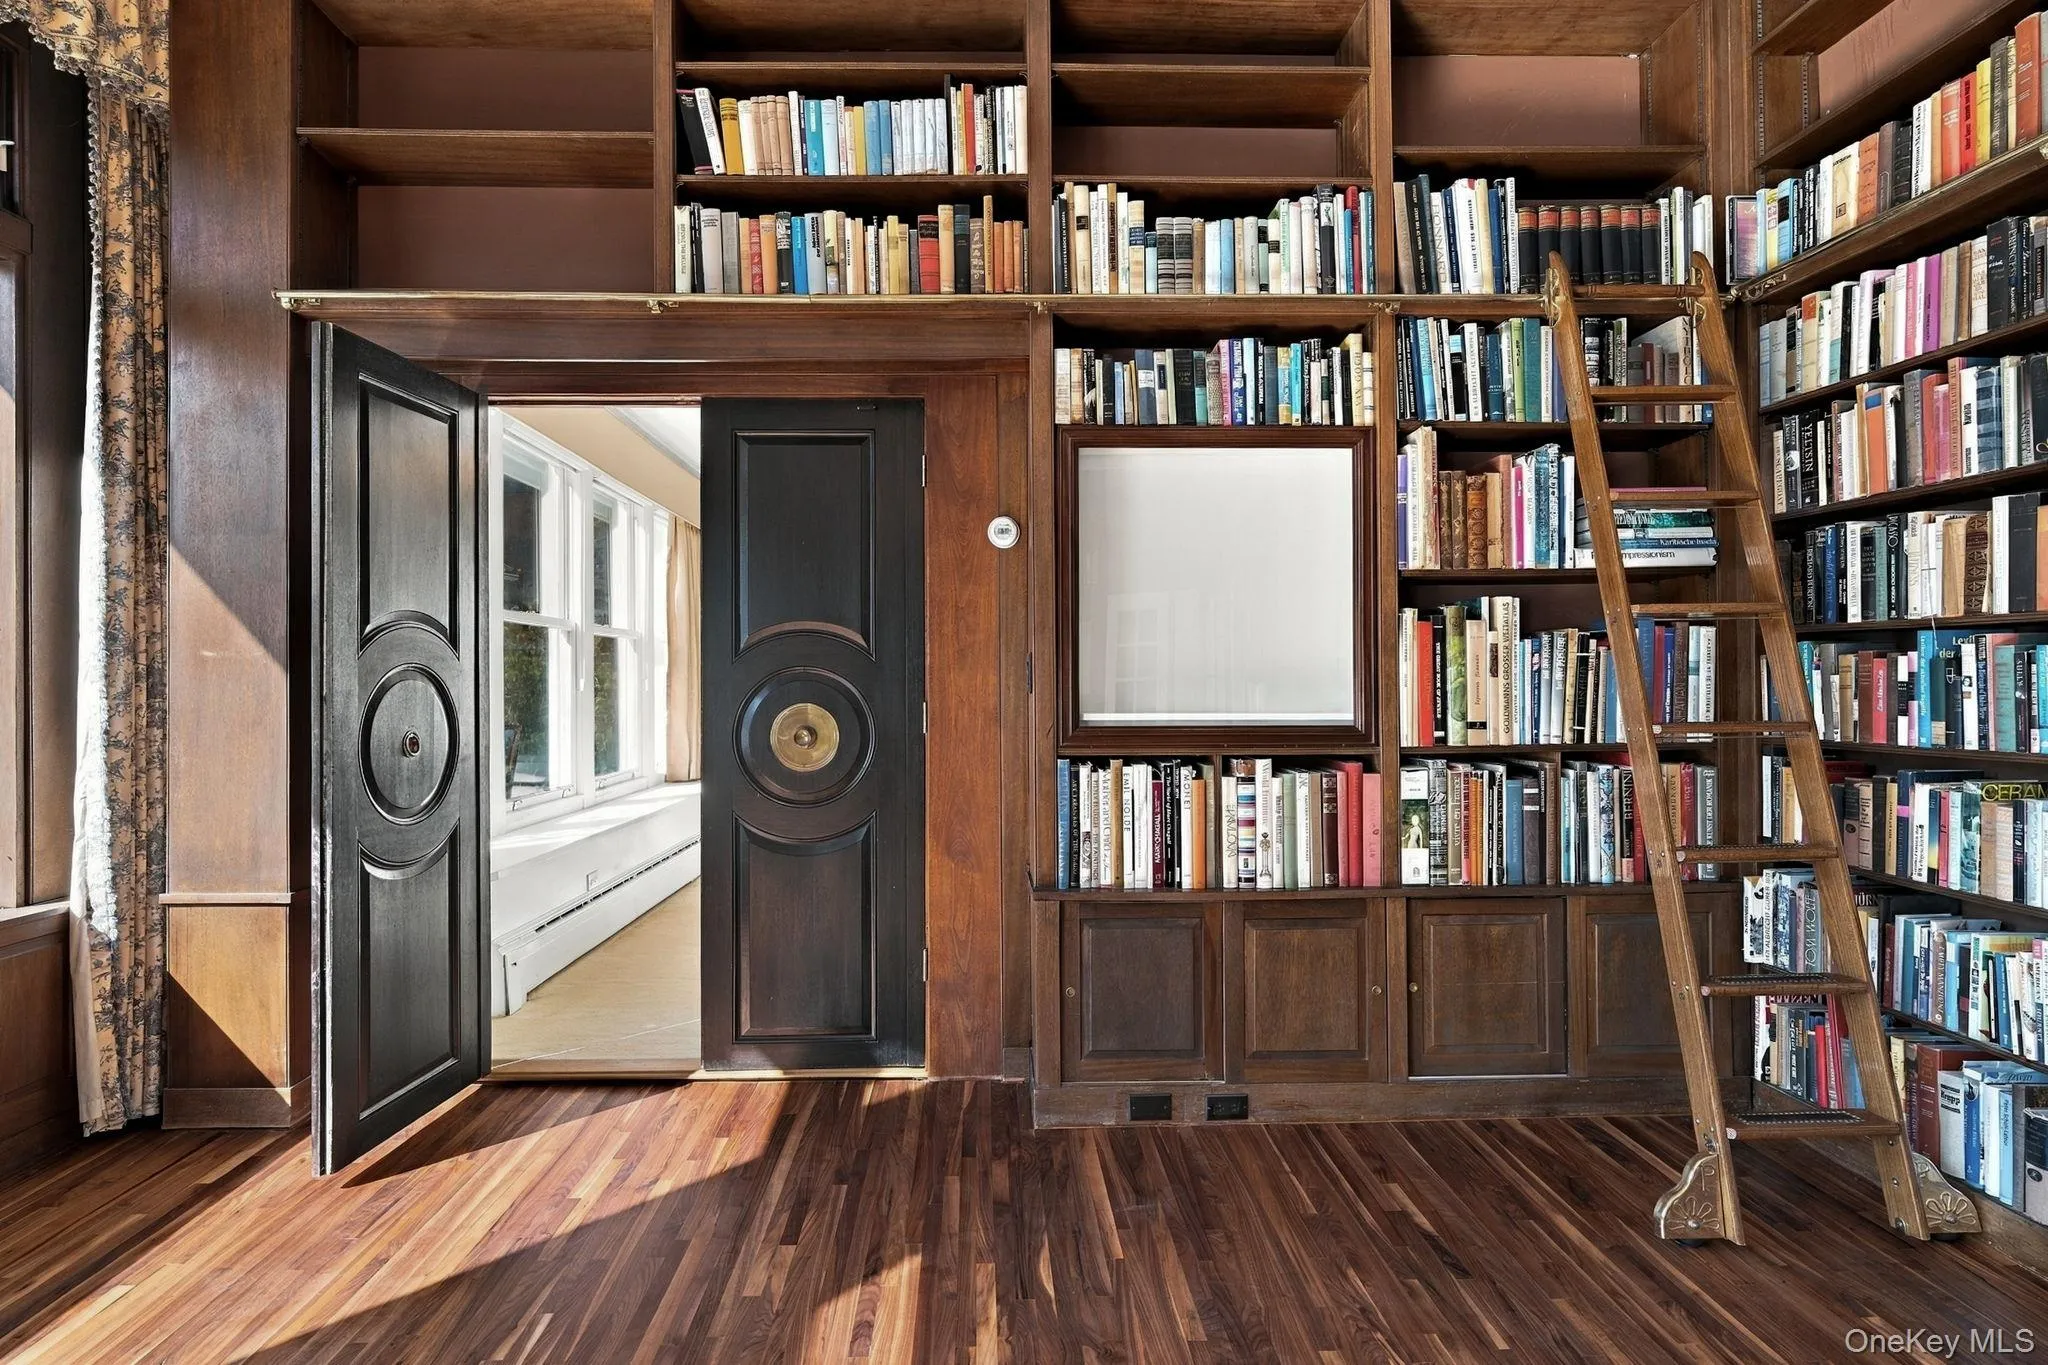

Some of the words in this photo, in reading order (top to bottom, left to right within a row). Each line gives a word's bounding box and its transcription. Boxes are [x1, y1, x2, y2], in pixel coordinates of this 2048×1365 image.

[1431, 204, 1447, 283] BONNARD
[1353, 351, 1362, 382] GOGH
[1804, 423, 1814, 472] YELTSIN
[1502, 644, 1511, 680] GROSSER
[1939, 648, 1955, 659] der
[2016, 659, 2026, 687] SULLY
[1502, 682, 1511, 734] GOLDMANNS
[1123, 772, 1131, 796] EMIL
[1183, 773, 1192, 811] MONET
[1450, 776, 1461, 805] France
[1623, 769, 1634, 820] BERNINI
[1706, 778, 1714, 806] ROMANIK
[1123, 798, 1131, 832] NOLDE
[1451, 807, 1460, 820] en
[1165, 823, 1173, 845] Chagall
[1450, 822, 1461, 846] vivre
[1154, 843, 1162, 864] MARC
[1804, 896, 1816, 933] WOLFE
[1804, 938, 1817, 968] TOM
